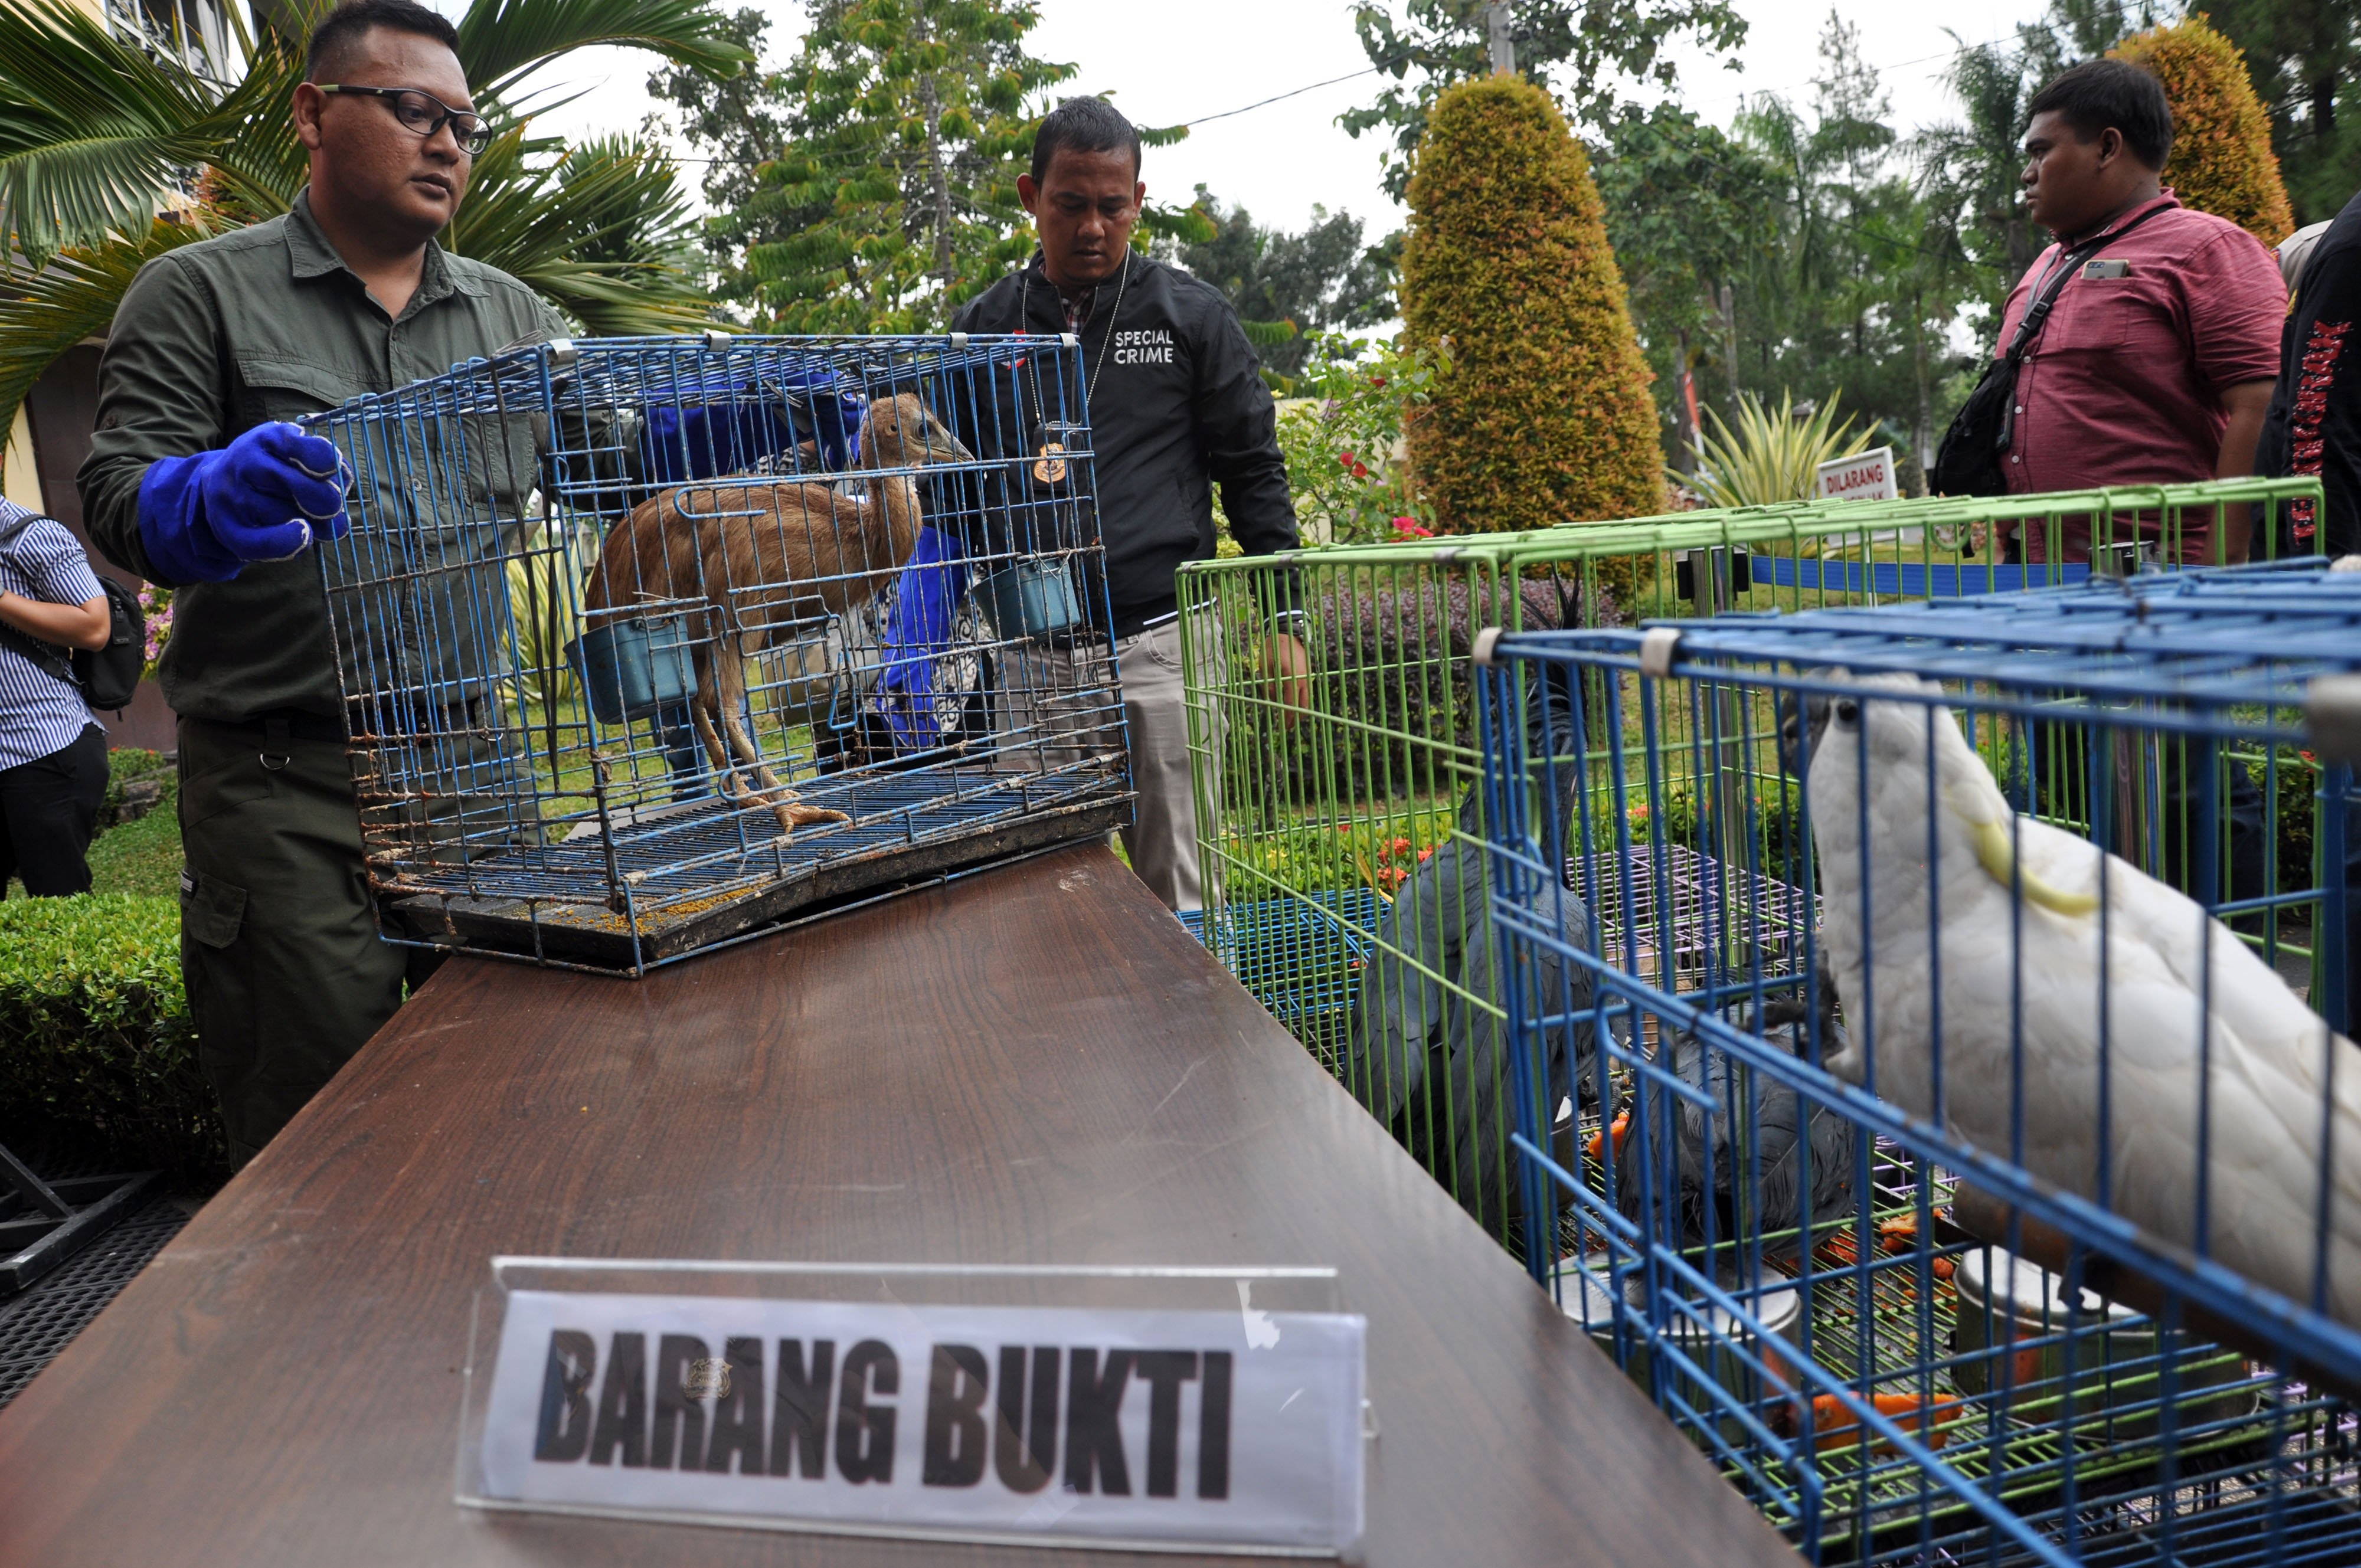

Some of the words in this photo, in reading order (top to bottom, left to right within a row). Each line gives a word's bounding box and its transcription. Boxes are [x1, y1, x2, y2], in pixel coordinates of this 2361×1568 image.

[1115, 330, 1173, 347] SPECIAL
[1114, 348, 1173, 364] CRIME
[2290, 320, 2352, 546] TEGKORAK
[1826, 464, 1883, 493] DILARANG
[533, 1328, 901, 1486] BARANG
[920, 1344, 1234, 1501] BUKTI
